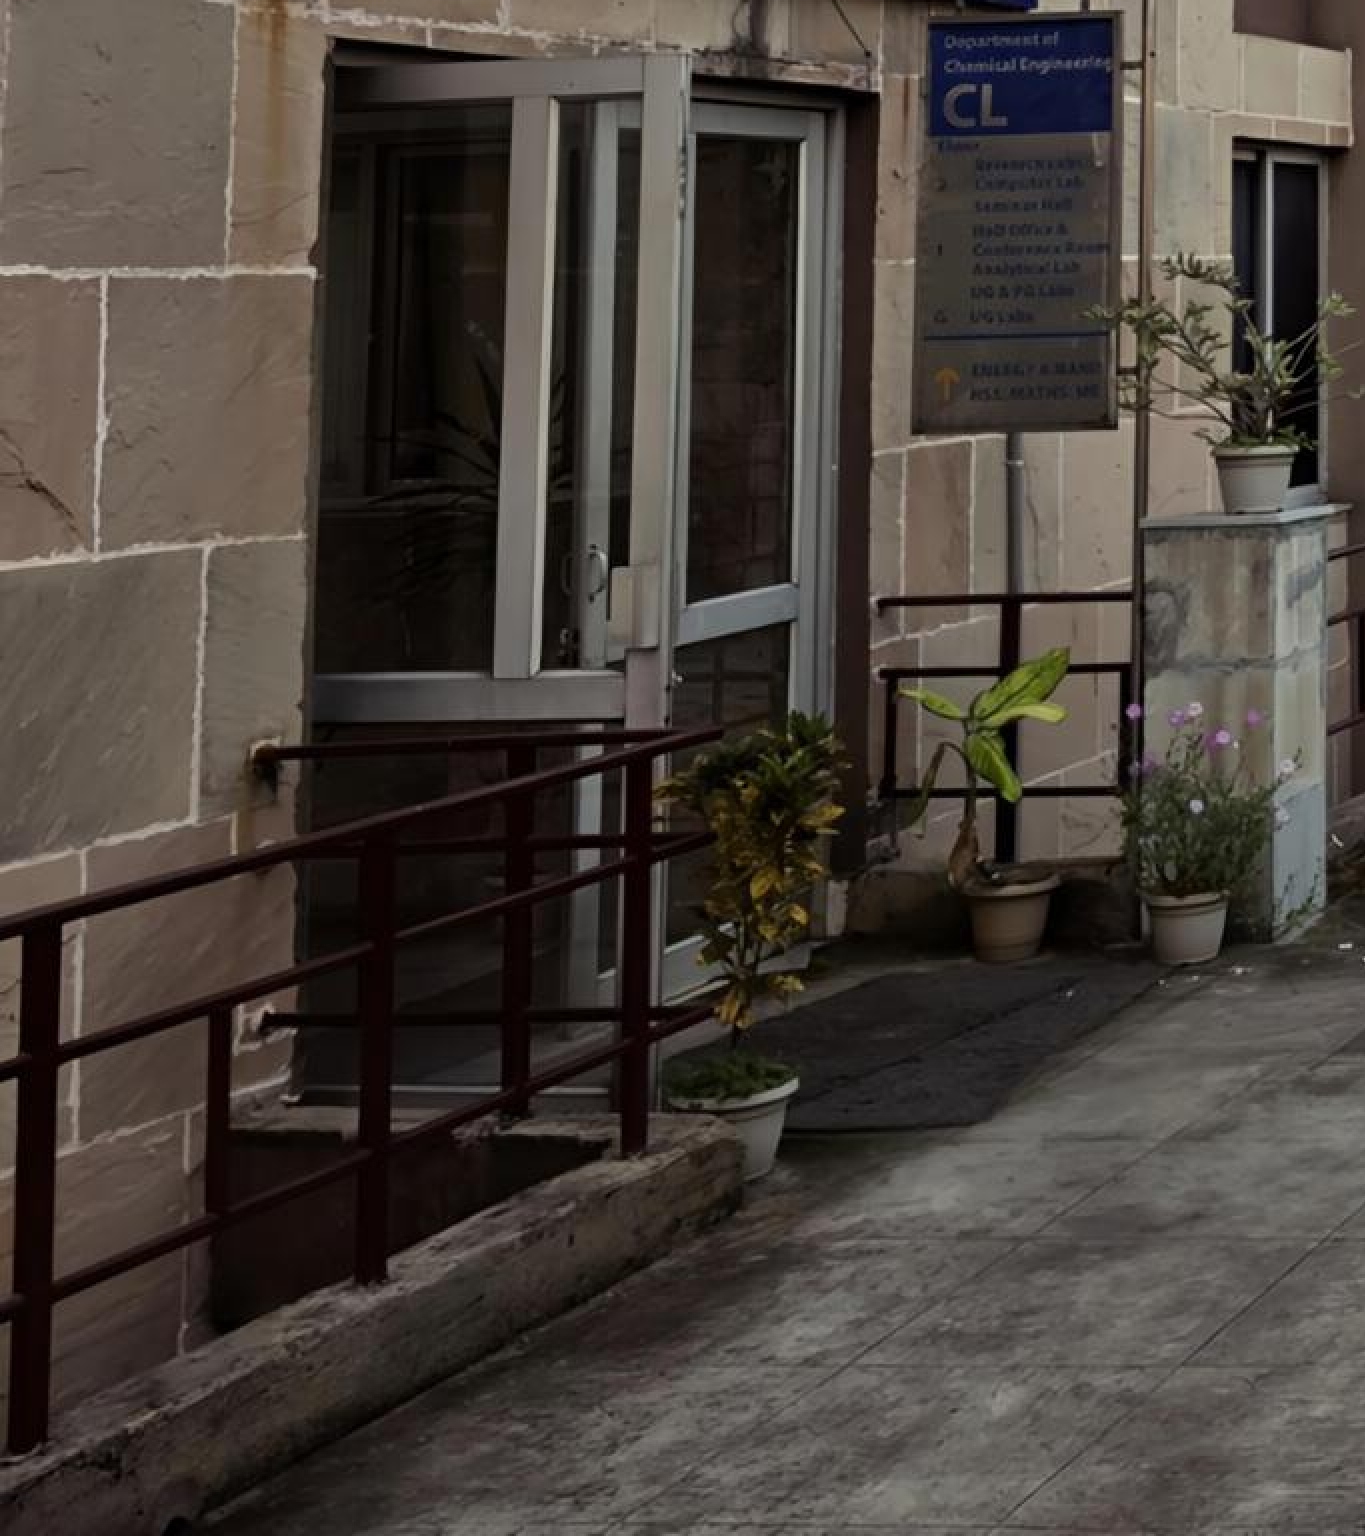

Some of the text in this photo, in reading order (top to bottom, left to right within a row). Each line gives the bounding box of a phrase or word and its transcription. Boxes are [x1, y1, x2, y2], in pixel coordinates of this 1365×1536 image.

[944, 35, 1038, 49] Department
[943, 57, 1018, 73] Chemical
[943, 83, 1009, 128] CL
